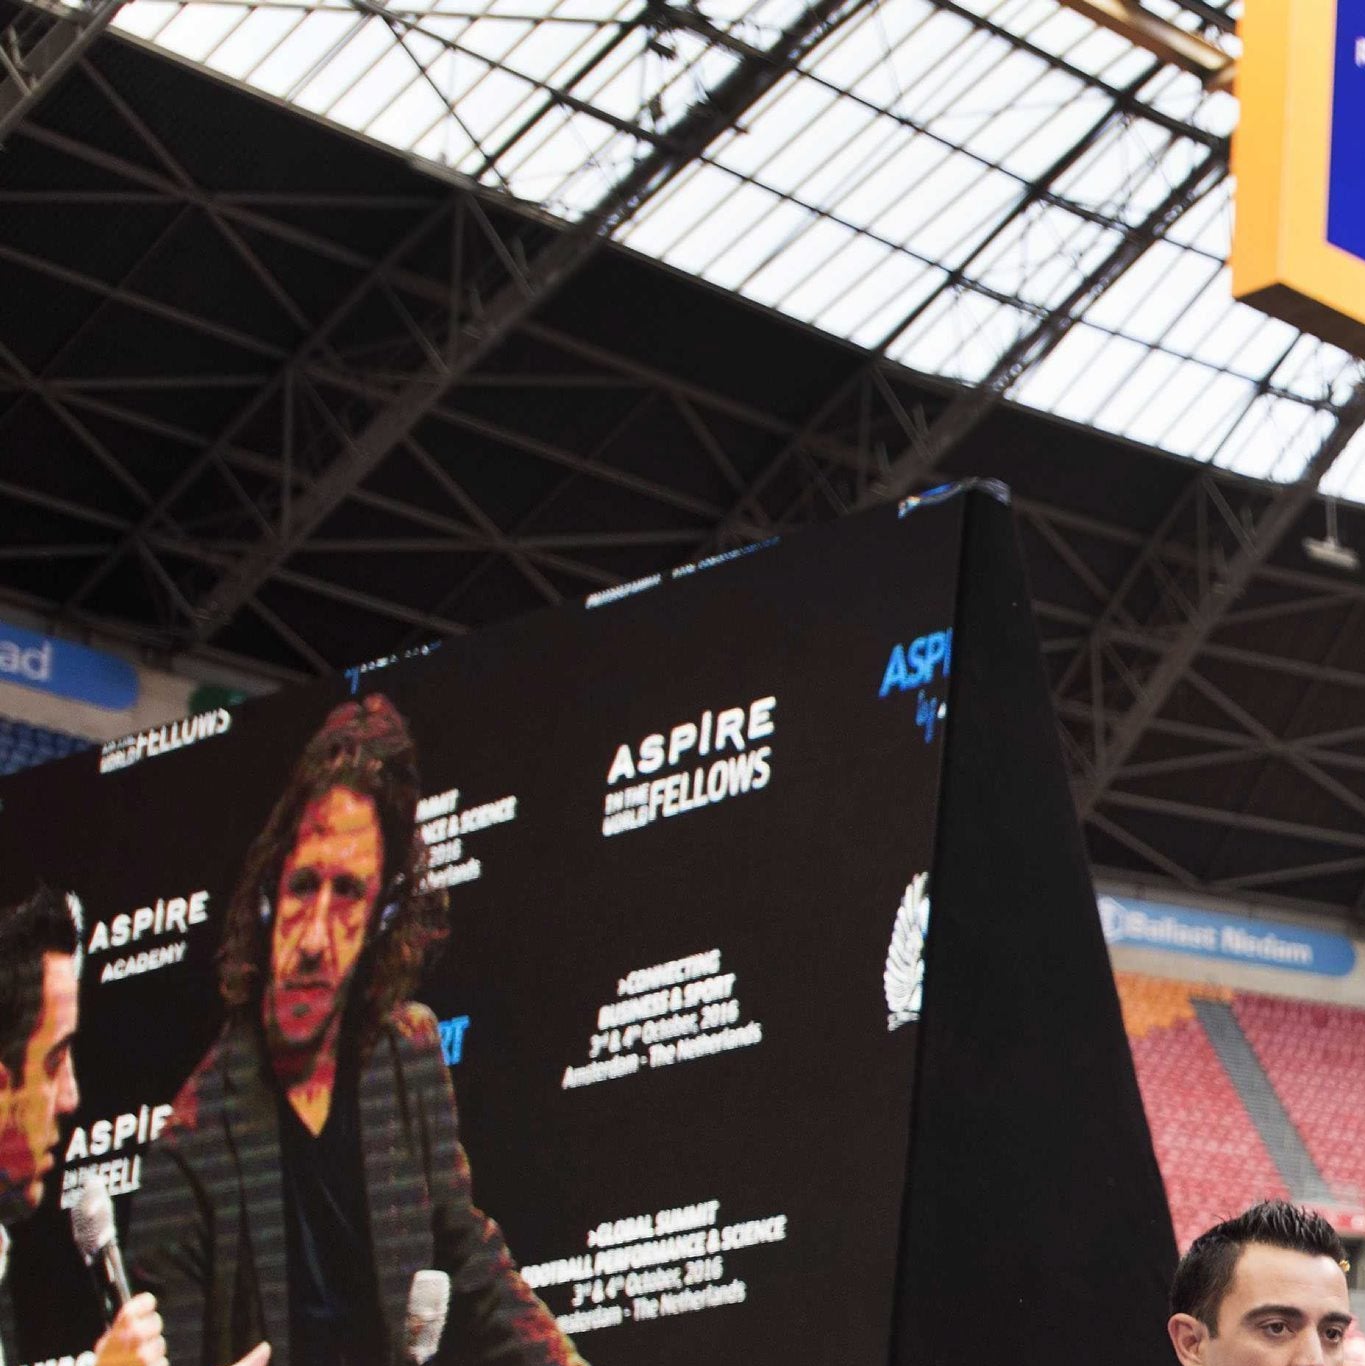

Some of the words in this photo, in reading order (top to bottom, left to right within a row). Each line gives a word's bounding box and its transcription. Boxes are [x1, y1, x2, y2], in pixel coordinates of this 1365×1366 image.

[606, 696, 777, 784] ASPIRE
[647, 746, 771, 820] FELLOWS
[89, 890, 210, 954] ASPIRE
[101, 941, 187, 983] ACADEMY
[721, 1214, 788, 1251] SCIENCE
